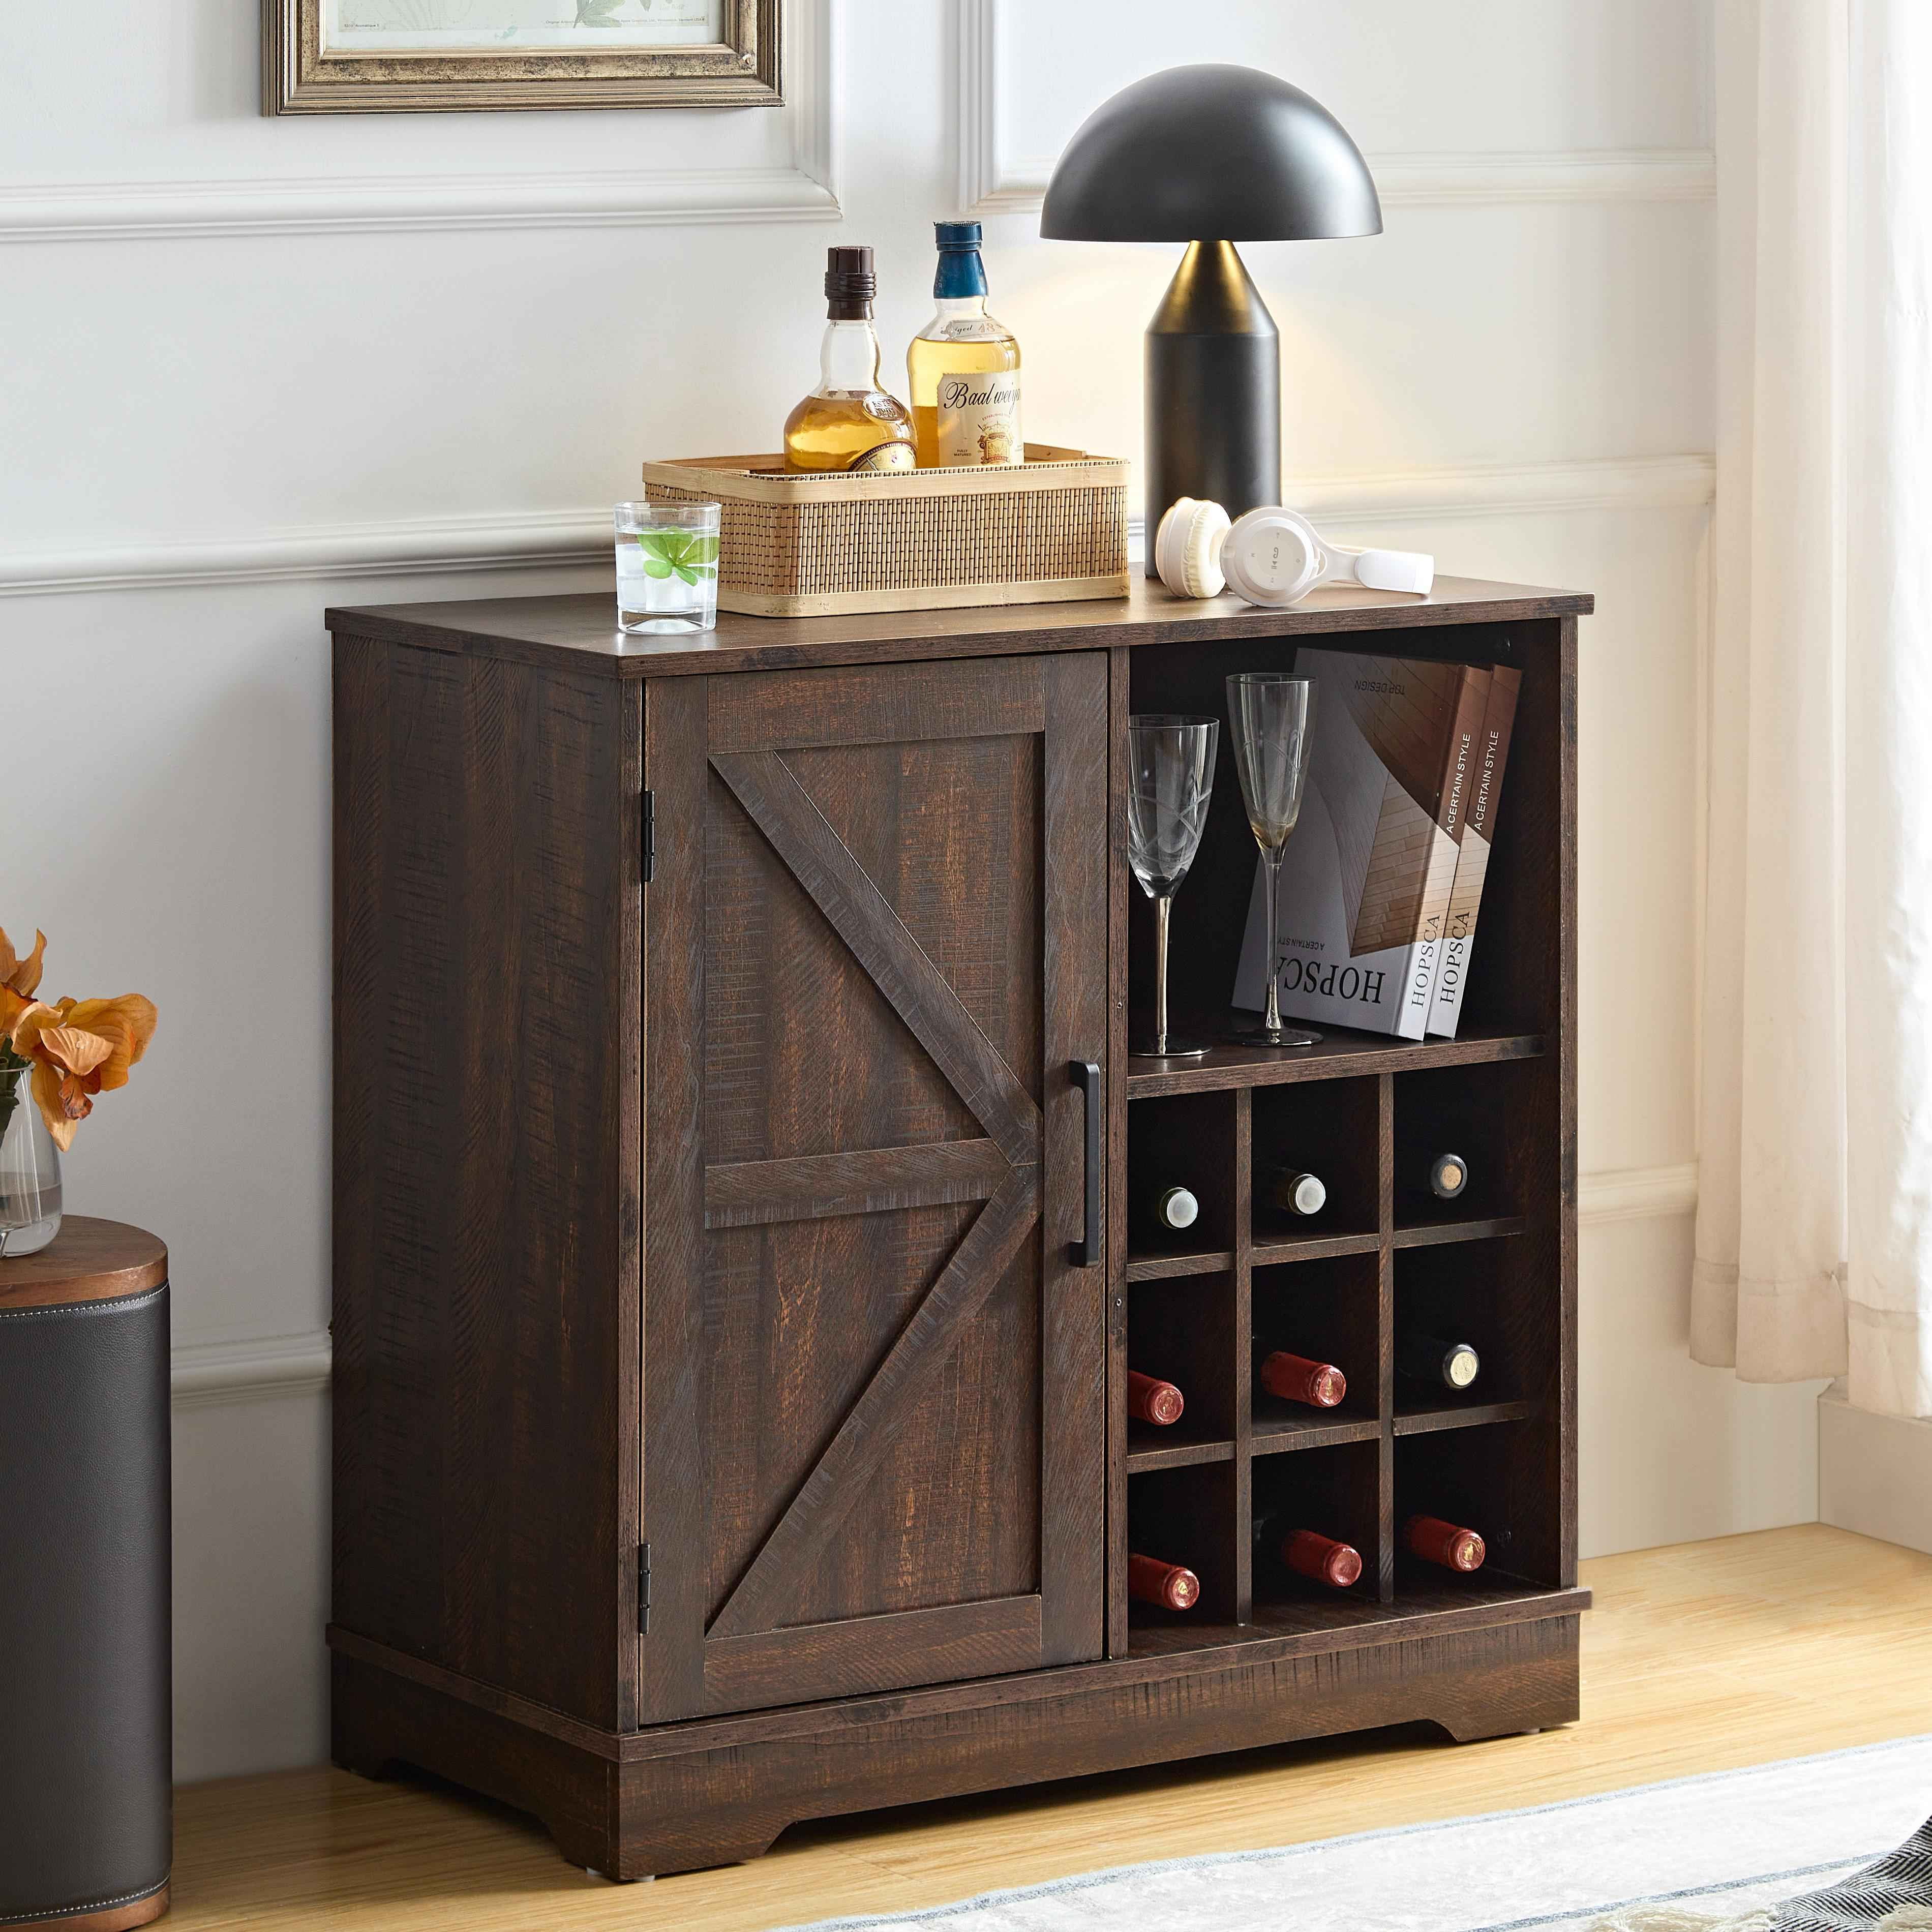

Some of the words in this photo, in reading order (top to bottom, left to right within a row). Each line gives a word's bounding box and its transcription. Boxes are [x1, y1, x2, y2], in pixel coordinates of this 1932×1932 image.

[944, 382, 995, 409] Baal
[1354, 680, 1387, 693] DESIGN
[1389, 683, 1405, 695] TOP
[1485, 730, 1499, 768] STYLE
[1447, 773, 1464, 824] CERTAIN
[1457, 733, 1471, 771] STYLE
[1475, 770, 1492, 821] CERTAIN
[1474, 822, 1483, 831] A
[1291, 939, 1319, 950] CERTAIN
[1320, 943, 1325, 951] A
[1440, 911, 1470, 1005] HOPSCA
[1411, 915, 1440, 1009] HOPSCA
